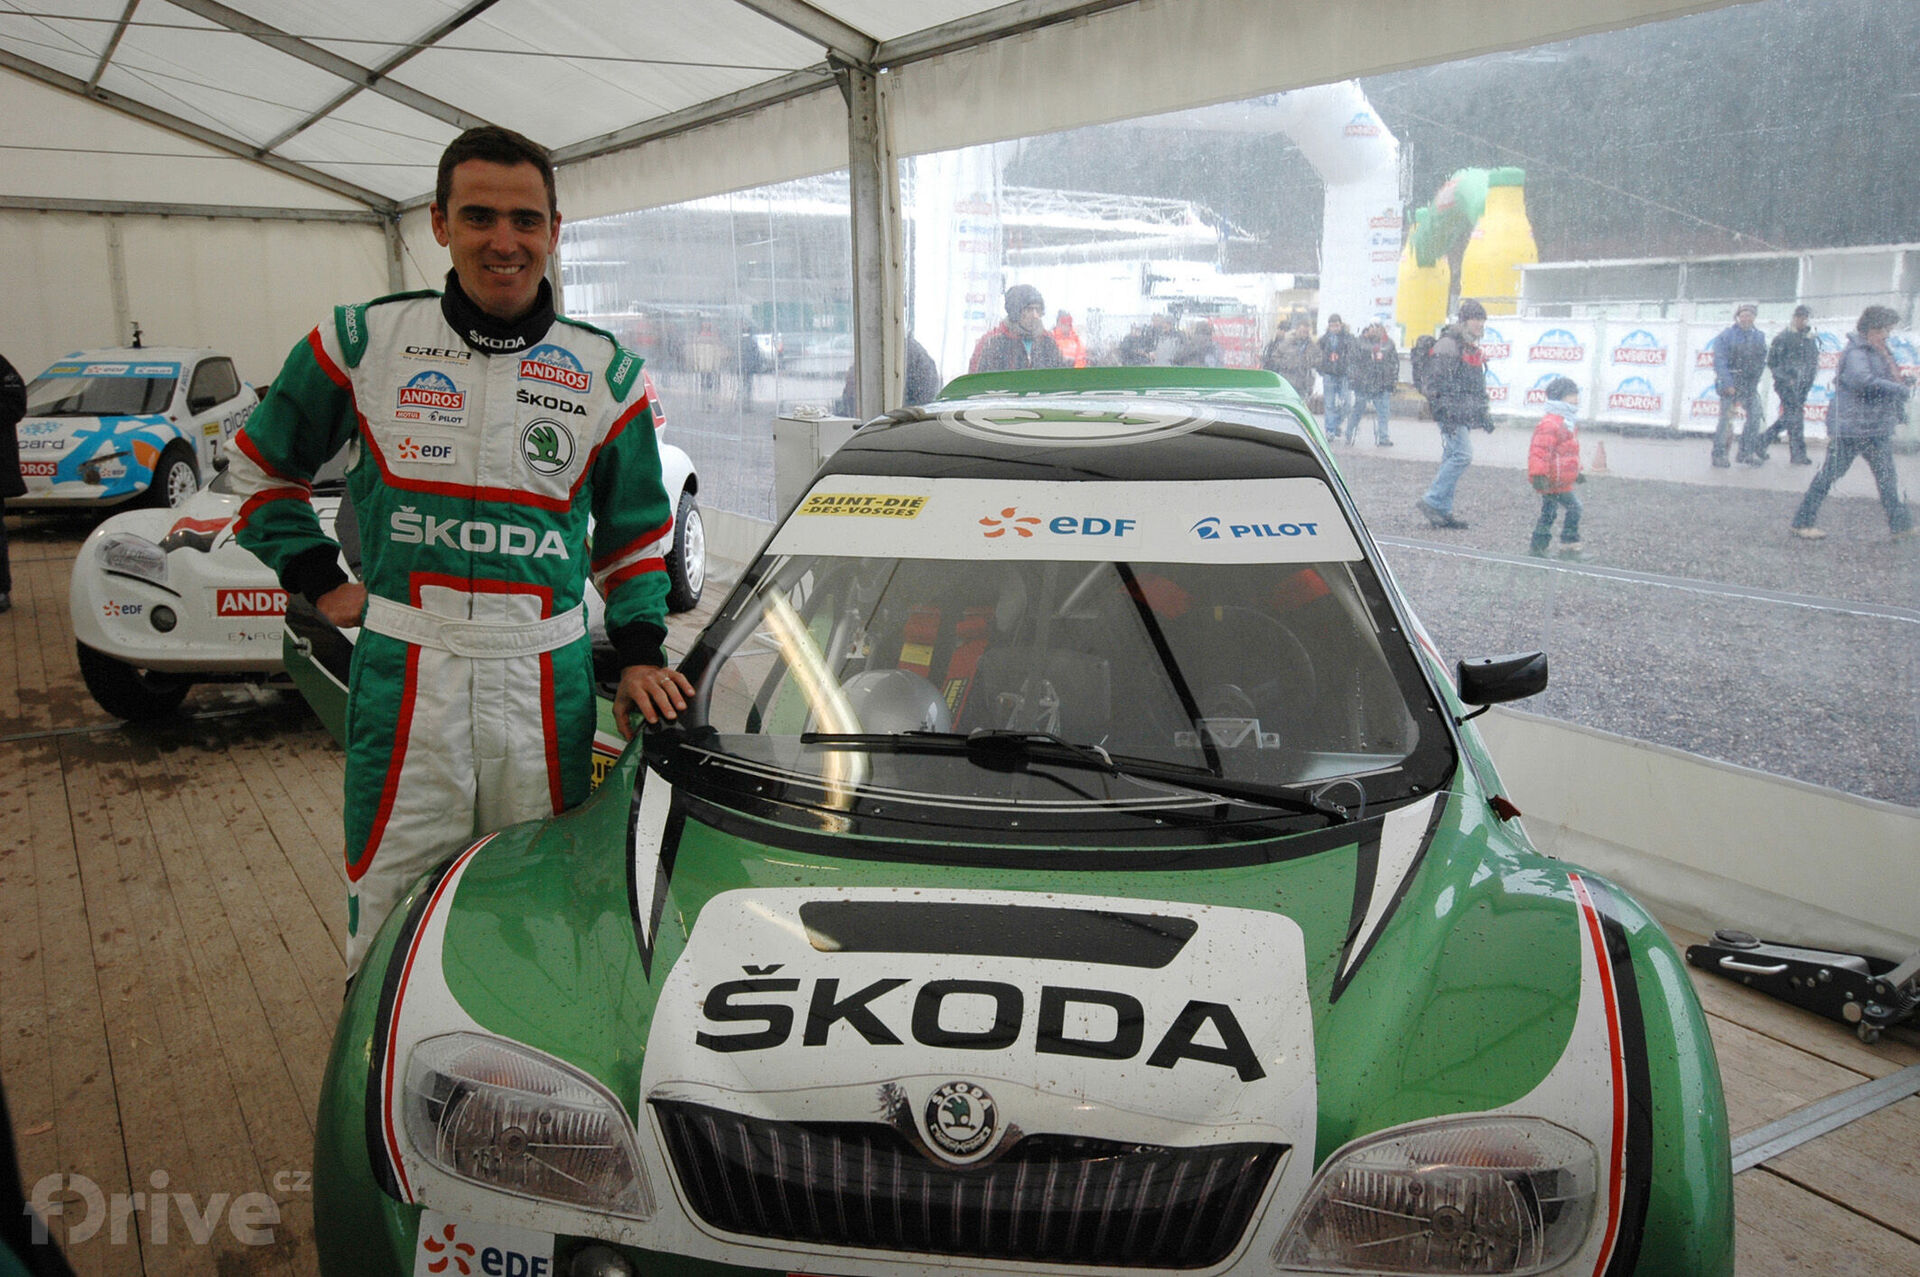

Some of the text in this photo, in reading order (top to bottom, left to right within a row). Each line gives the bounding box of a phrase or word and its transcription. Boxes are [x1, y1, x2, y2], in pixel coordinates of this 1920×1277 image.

[405, 346, 472, 360] ORECA
[1532, 347, 1582, 359] ANDROS
[522, 362, 585, 388] ANDROS
[402, 390, 460, 407] ANDROS
[516, 388, 587, 416] ŠKODA
[438, 415, 463, 423] PILOT
[18, 439, 65, 450] card
[421, 445, 452, 458] eDF
[20, 464, 55, 475] DROS
[808, 497, 923, 508] SAINT-DIÉ
[803, 506, 916, 516] -DES-VOSGES
[391, 505, 570, 560] ŠKODA
[1050, 516, 1318, 538] eDF PILOT
[221, 592, 288, 612] ANDR
[122, 604, 143, 615] eDF
[696, 963, 1267, 1082] ŠKODA
